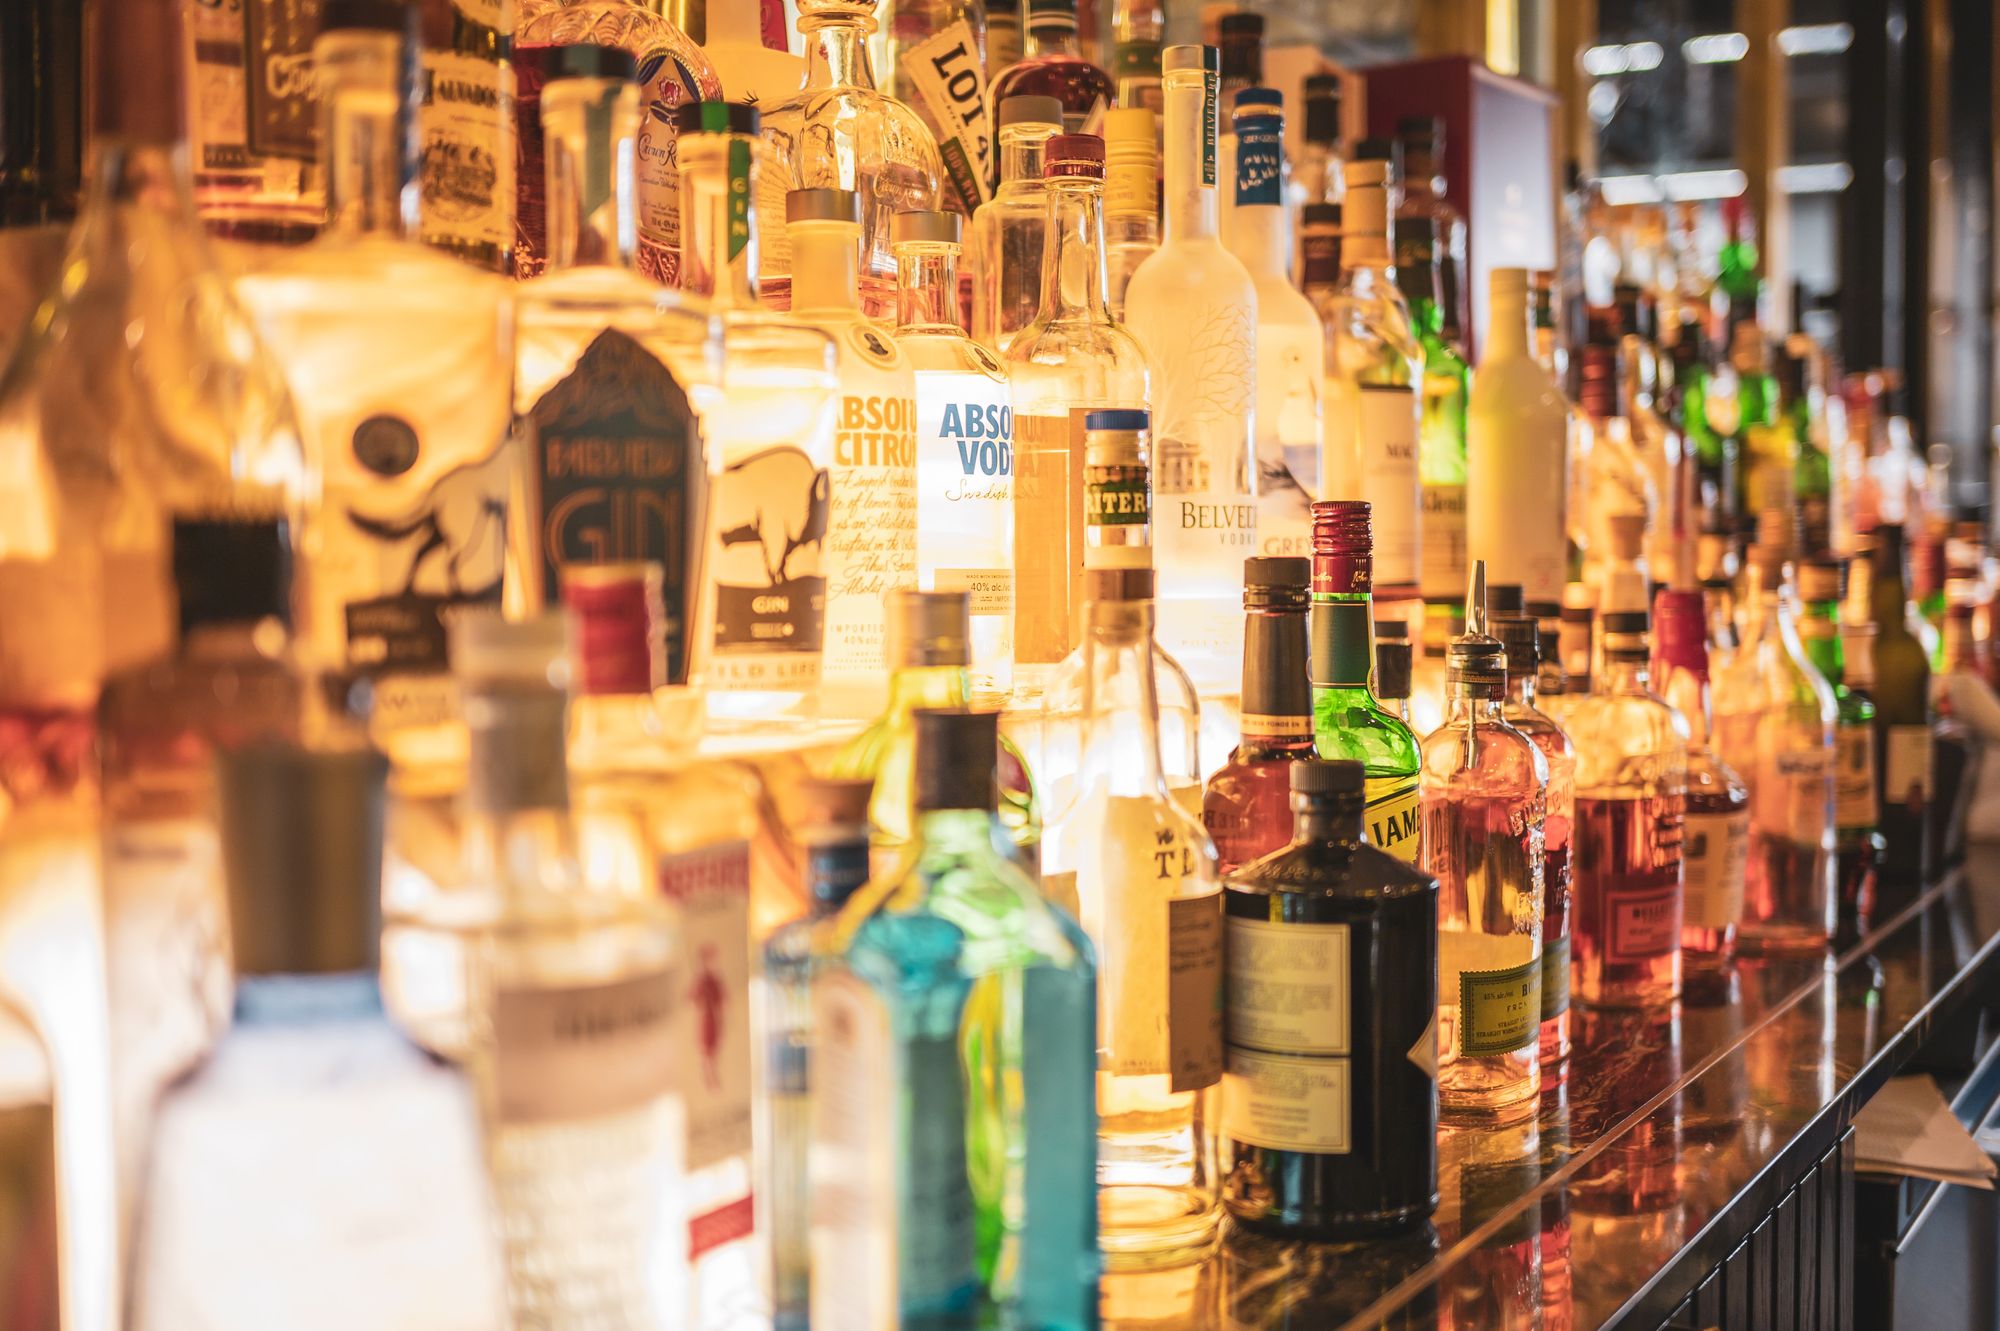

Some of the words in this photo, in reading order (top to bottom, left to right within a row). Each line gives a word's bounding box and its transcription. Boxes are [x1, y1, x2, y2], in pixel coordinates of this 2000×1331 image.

[931, 41, 985, 127] LOT
[730, 176, 749, 237] GIN
[752, 595, 790, 614] GIN
[971, 582, 989, 592] 40%
